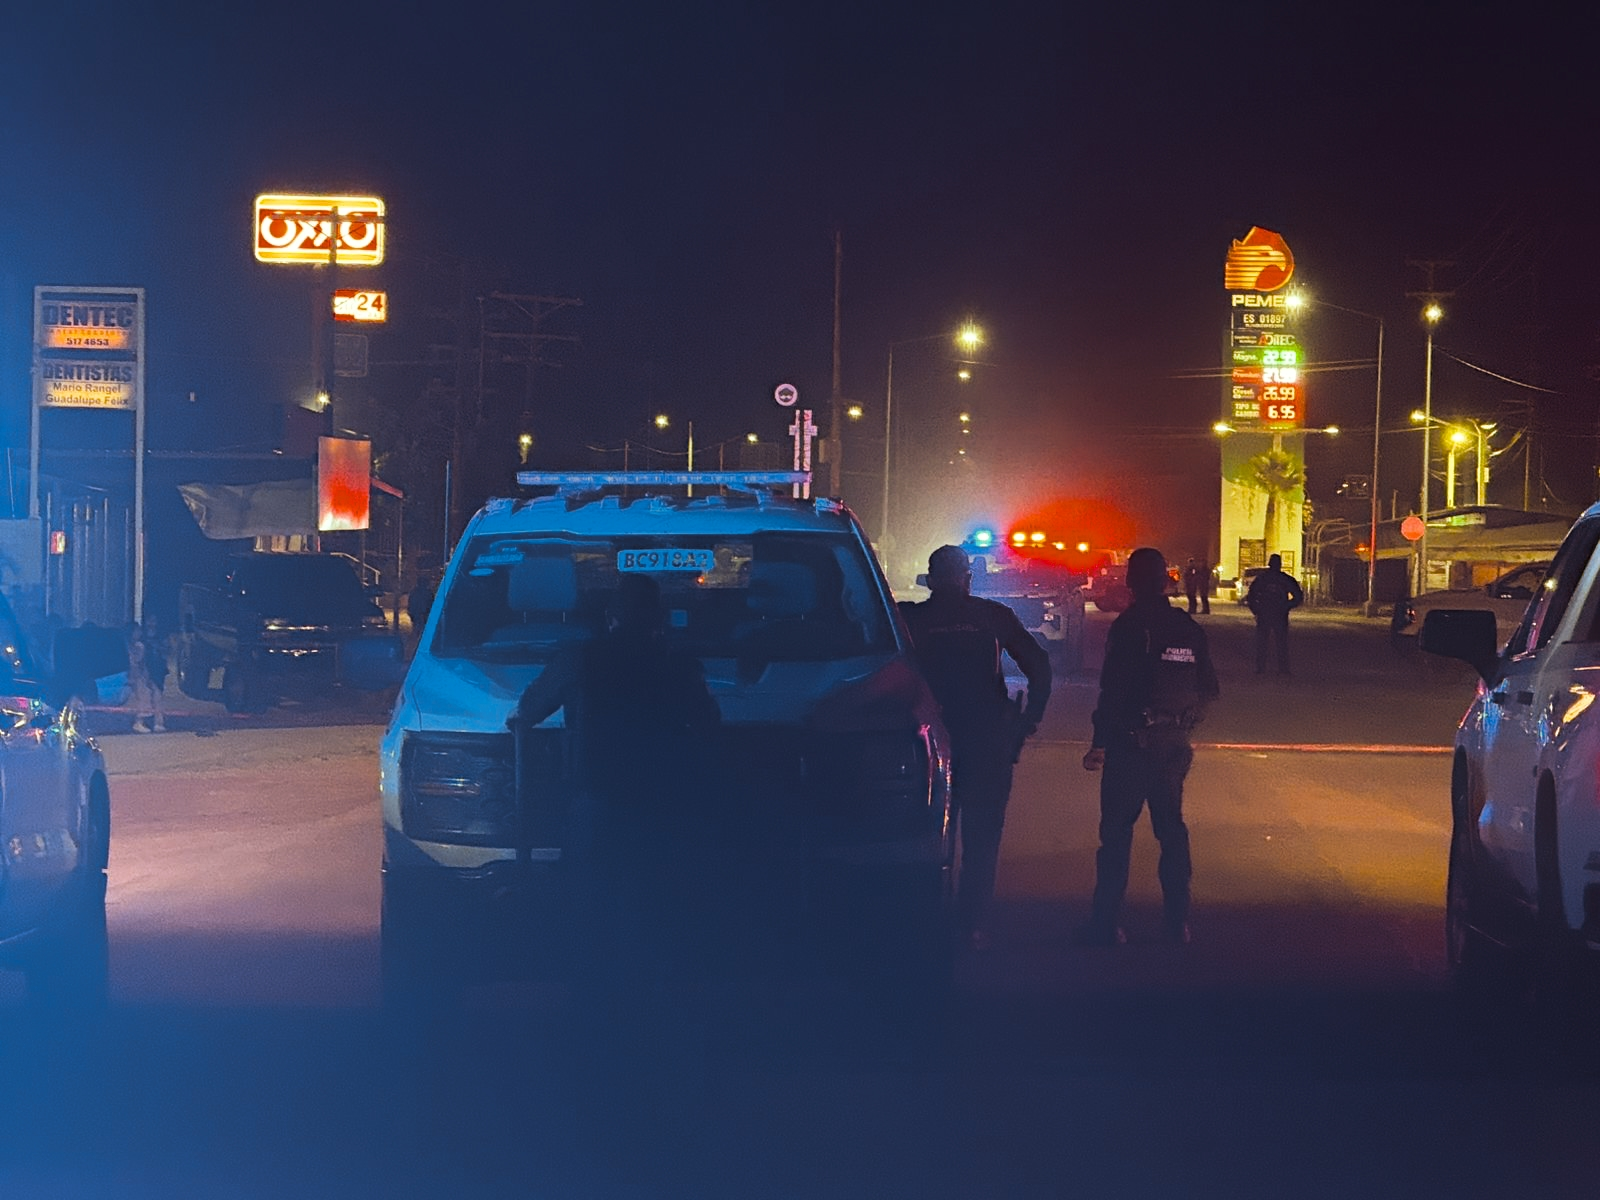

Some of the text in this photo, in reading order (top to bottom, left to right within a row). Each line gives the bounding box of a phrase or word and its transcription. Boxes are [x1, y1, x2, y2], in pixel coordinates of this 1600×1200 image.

[261, 210, 376, 249] OXXO
[1232, 294, 1297, 307] PEME
[42, 304, 134, 328] DENTEC
[1243, 314, 1255, 323] ES
[42, 363, 132, 382] DENTISTAS
[53, 383, 120, 394] Mario Rangel
[46, 394, 101, 406] Guadalupe
